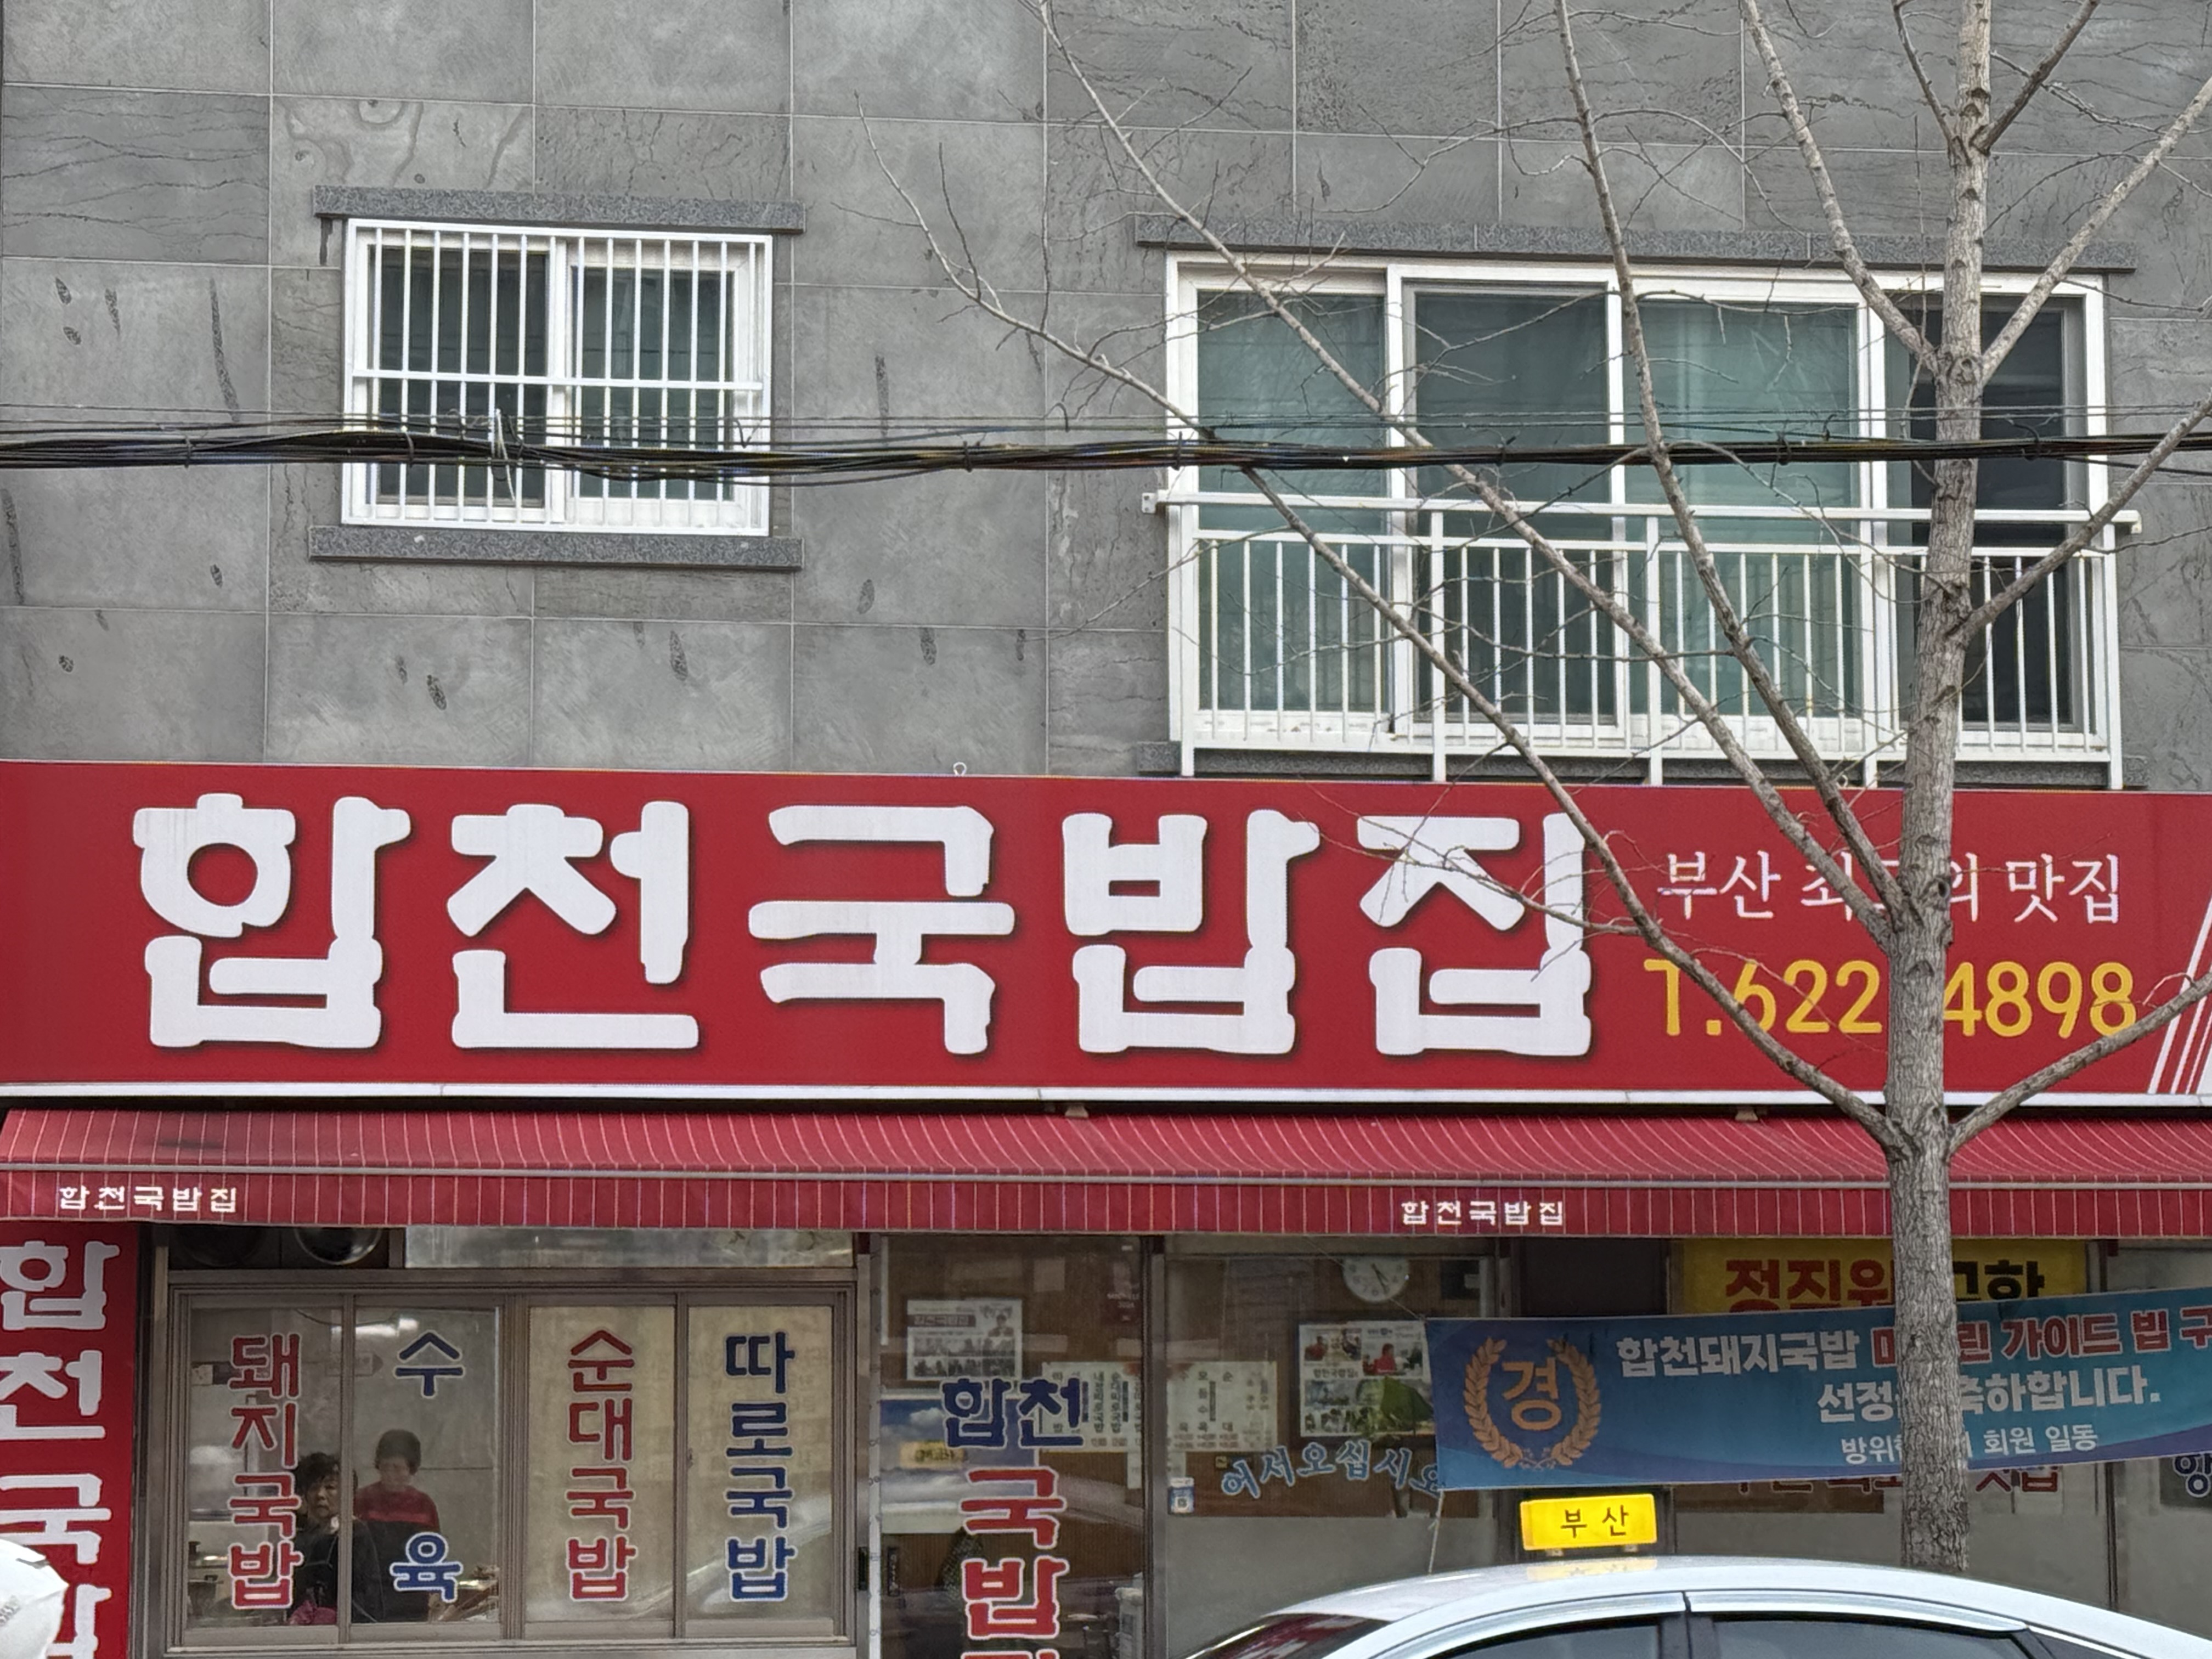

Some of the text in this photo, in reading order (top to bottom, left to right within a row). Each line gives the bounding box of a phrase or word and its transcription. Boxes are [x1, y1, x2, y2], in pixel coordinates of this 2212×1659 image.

[1657, 851, 2119, 924] 부산 최의 맛집
[133, 793, 1592, 1056] 합천국밥집
[59, 1186, 238, 1214] 합천국밥집
[1401, 1200, 1565, 1227] 합천국밥집
[1616, 1329, 1860, 1378] 합천돼지국밥
[2001, 1312, 2123, 1361] 가이드
[2130, 1308, 2171, 1354] 빕
[941, 1377, 1085, 1448] 합천
[1502, 1356, 1562, 1431] 경
[1817, 1380, 1901, 1423] 선정
[227, 1331, 304, 1610] 돼지국밥
[566, 1328, 637, 1602] 순대국밥
[724, 1329, 797, 1602] 따로국밥
[1983, 1427, 2036, 1457] 회원
[2045, 1424, 2098, 1453] 일동
[1560, 1504, 1629, 1539] 부산
